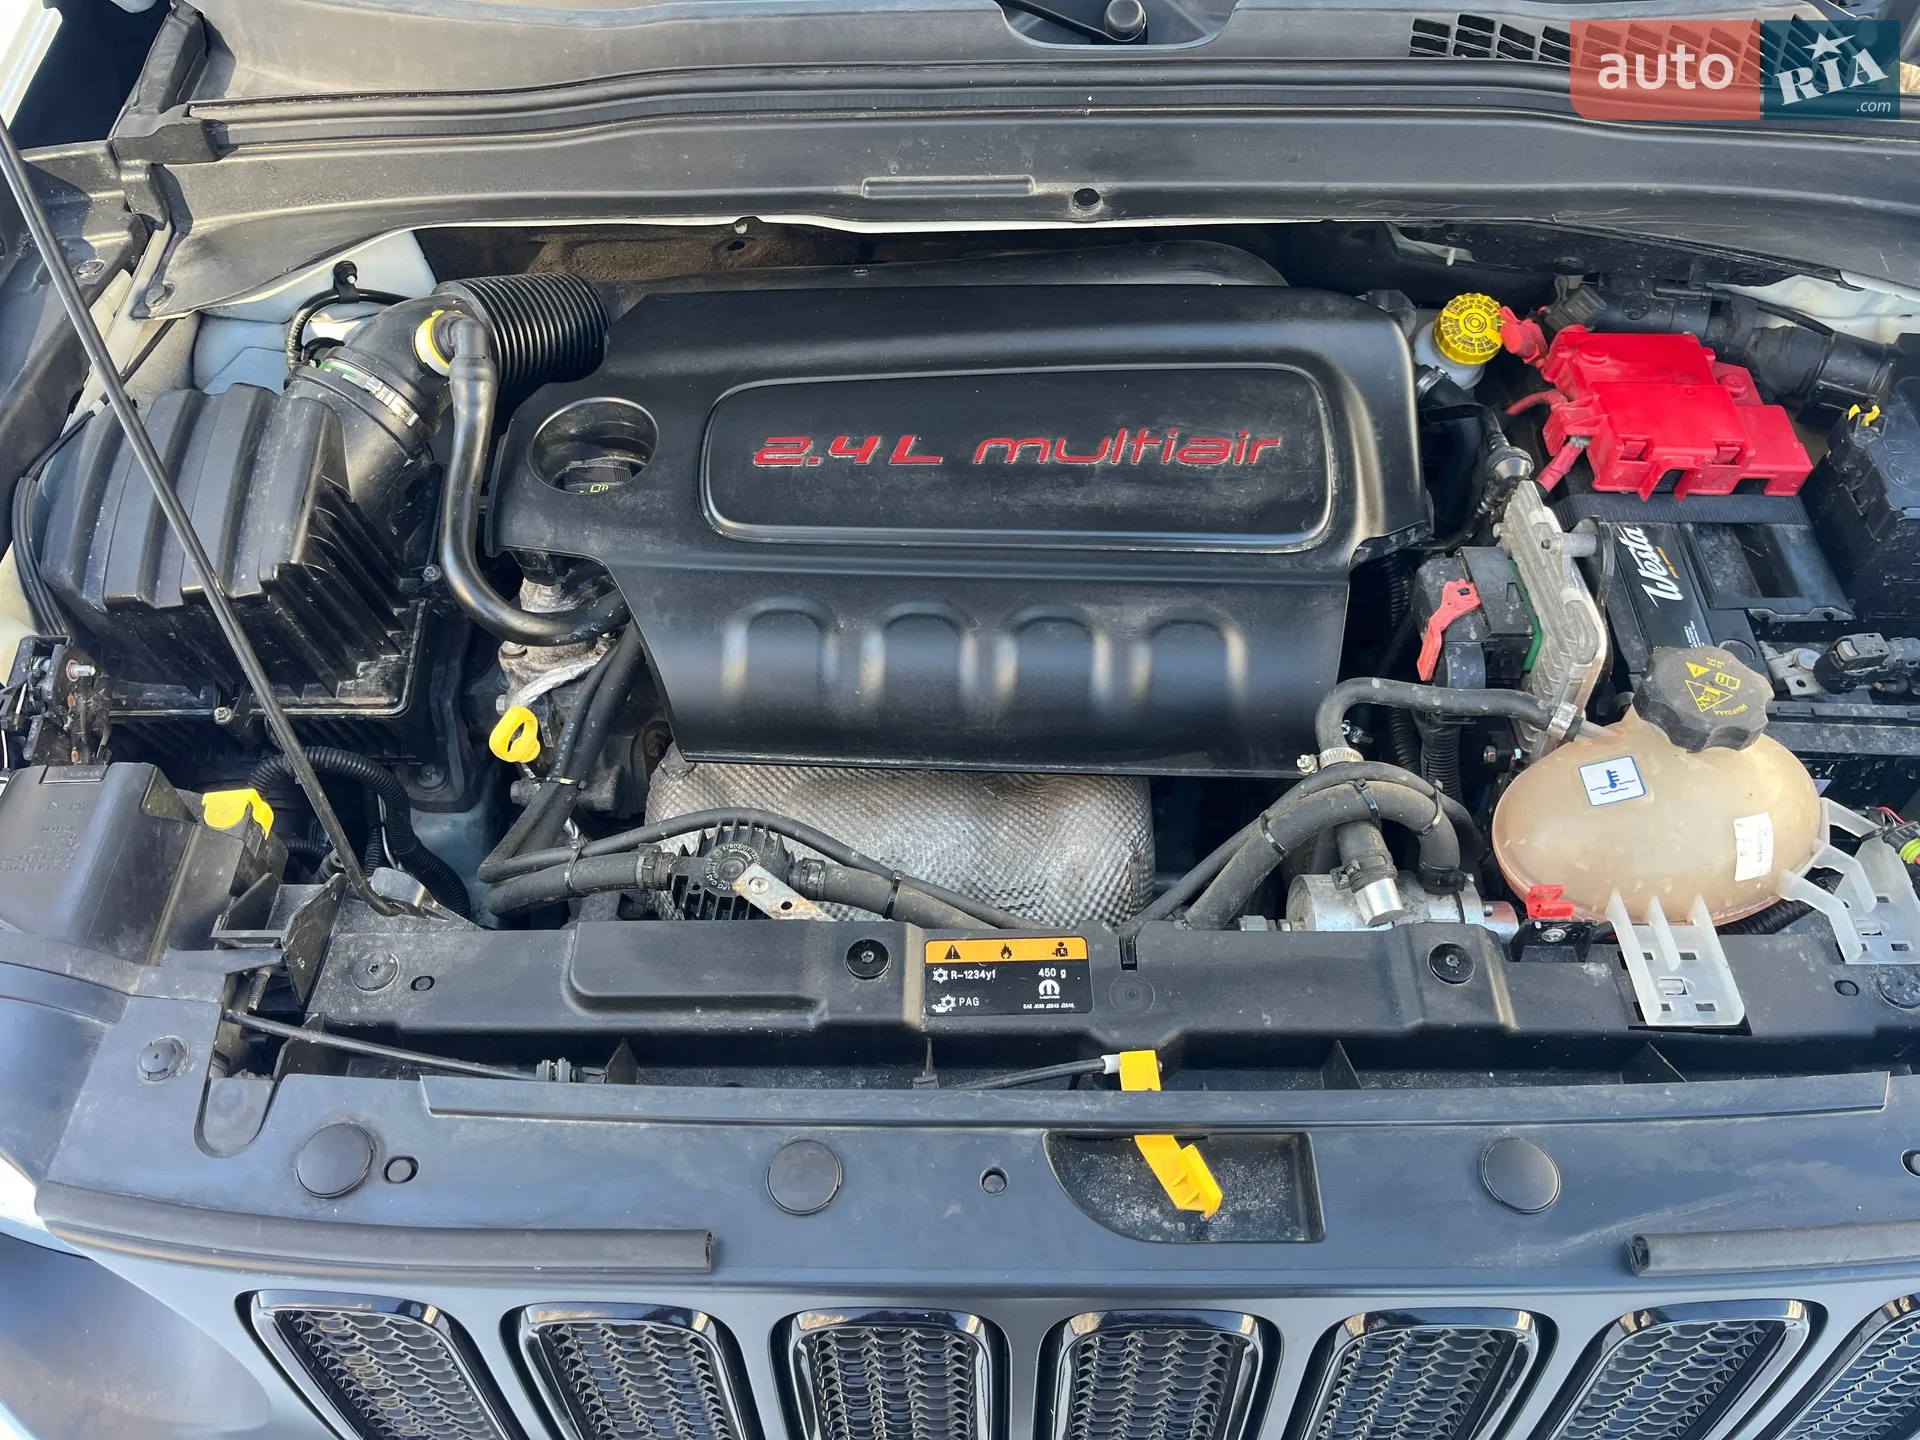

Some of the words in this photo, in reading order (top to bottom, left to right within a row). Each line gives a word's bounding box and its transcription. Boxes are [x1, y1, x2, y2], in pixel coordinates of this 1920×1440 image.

[753, 435, 944, 467] 2.4L
[973, 427, 1280, 465] multiair
[1617, 523, 1684, 609] Westa
[950, 968, 996, 981] R-1234yf
[1038, 967, 1057, 978] 450
[1060, 968, 1067, 979] g
[958, 996, 980, 1006] PAG
